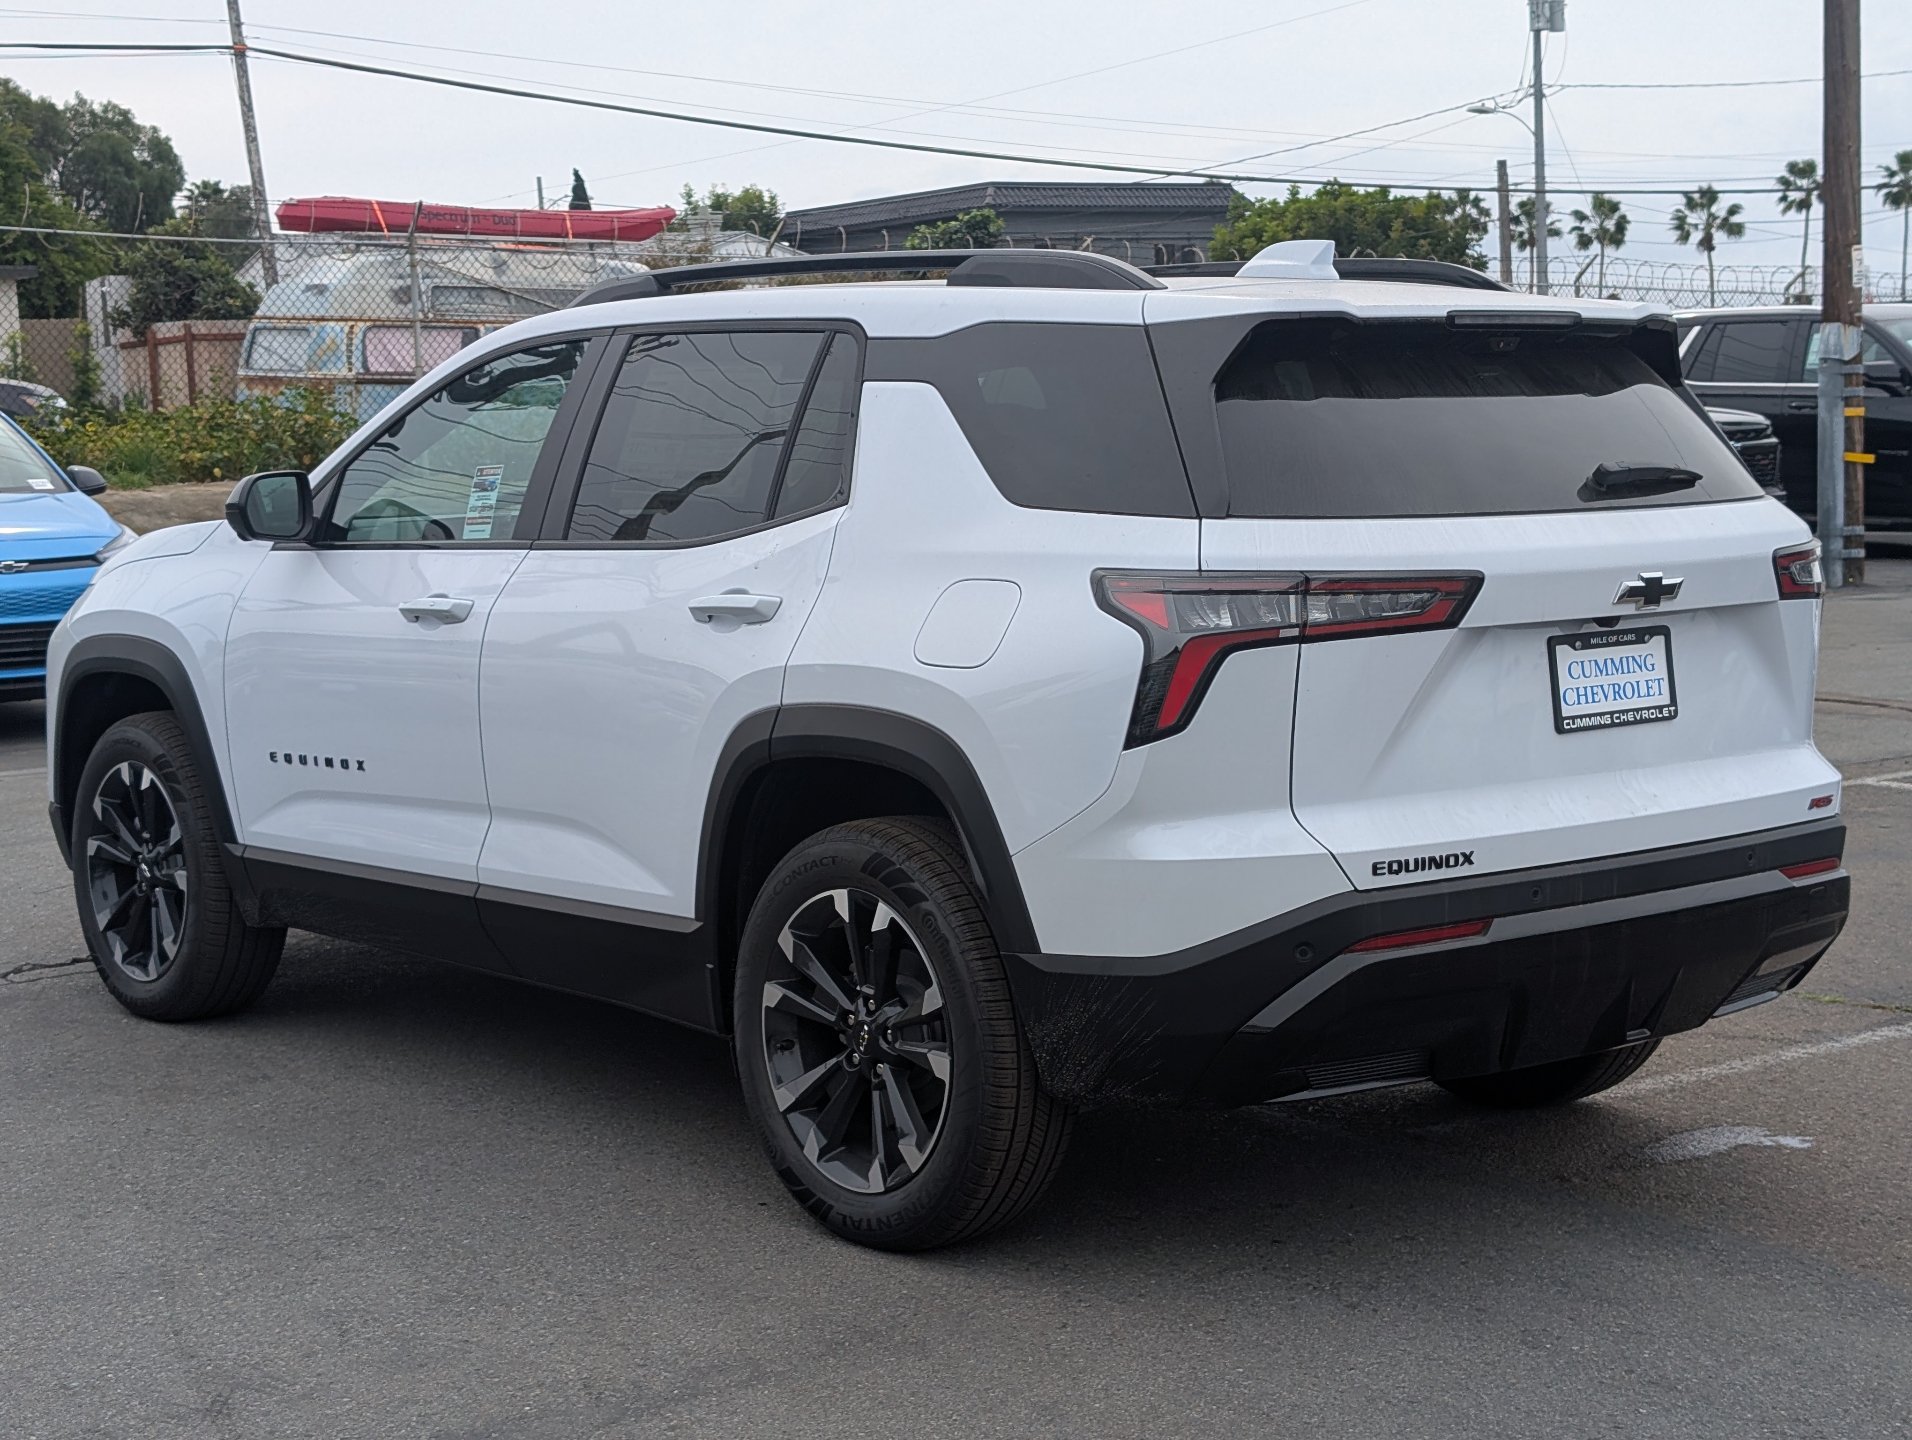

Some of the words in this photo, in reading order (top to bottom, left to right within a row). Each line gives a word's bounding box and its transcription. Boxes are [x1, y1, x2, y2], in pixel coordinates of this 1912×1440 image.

[1590, 635, 1607, 645] MILE
[1608, 635, 1618, 643] OF
[1618, 633, 1636, 642] CARS
[1567, 653, 1656, 680] CUMMING
[1562, 677, 1665, 707] CHEVROLET
[1563, 714, 1612, 729] CUMMING
[1613, 706, 1676, 723] CHEVROLET
[269, 751, 366, 772] EQUINOX
[1371, 850, 1475, 876] EQUINOX
